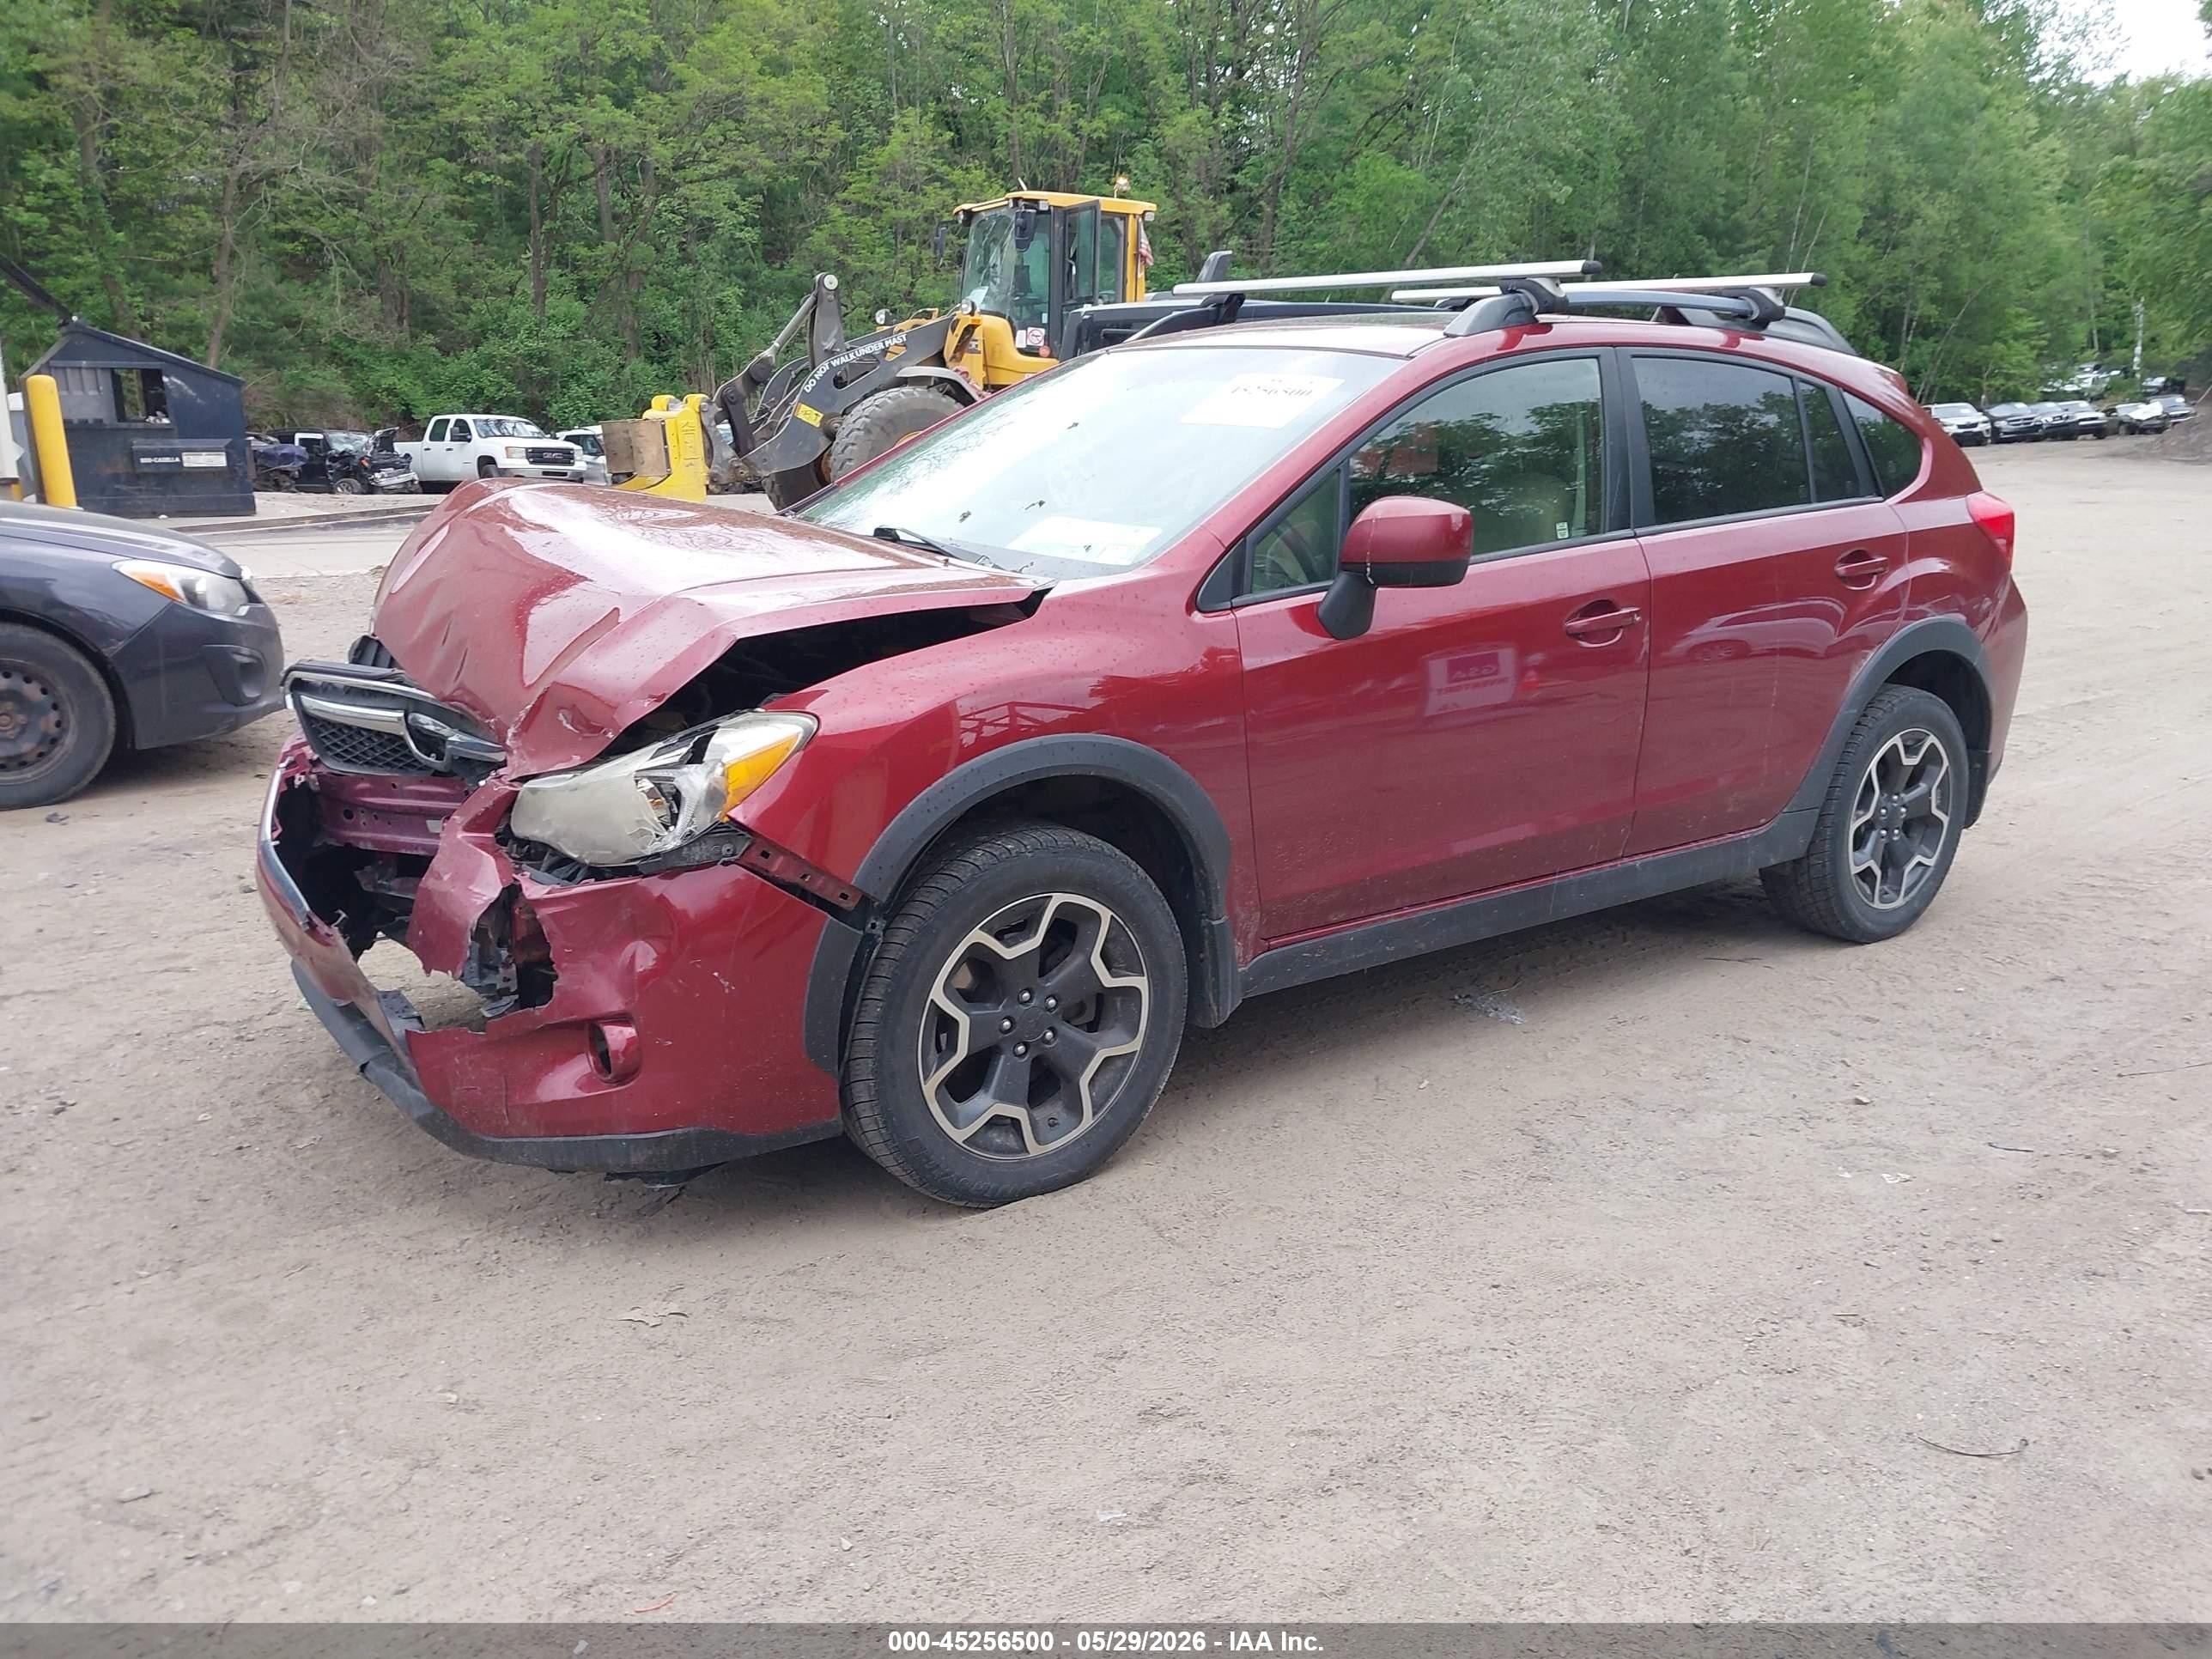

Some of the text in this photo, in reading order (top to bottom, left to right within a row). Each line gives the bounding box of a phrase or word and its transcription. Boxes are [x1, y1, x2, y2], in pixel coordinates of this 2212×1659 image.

[803, 333, 908, 393] DO NOT WALK UNDER MAST
